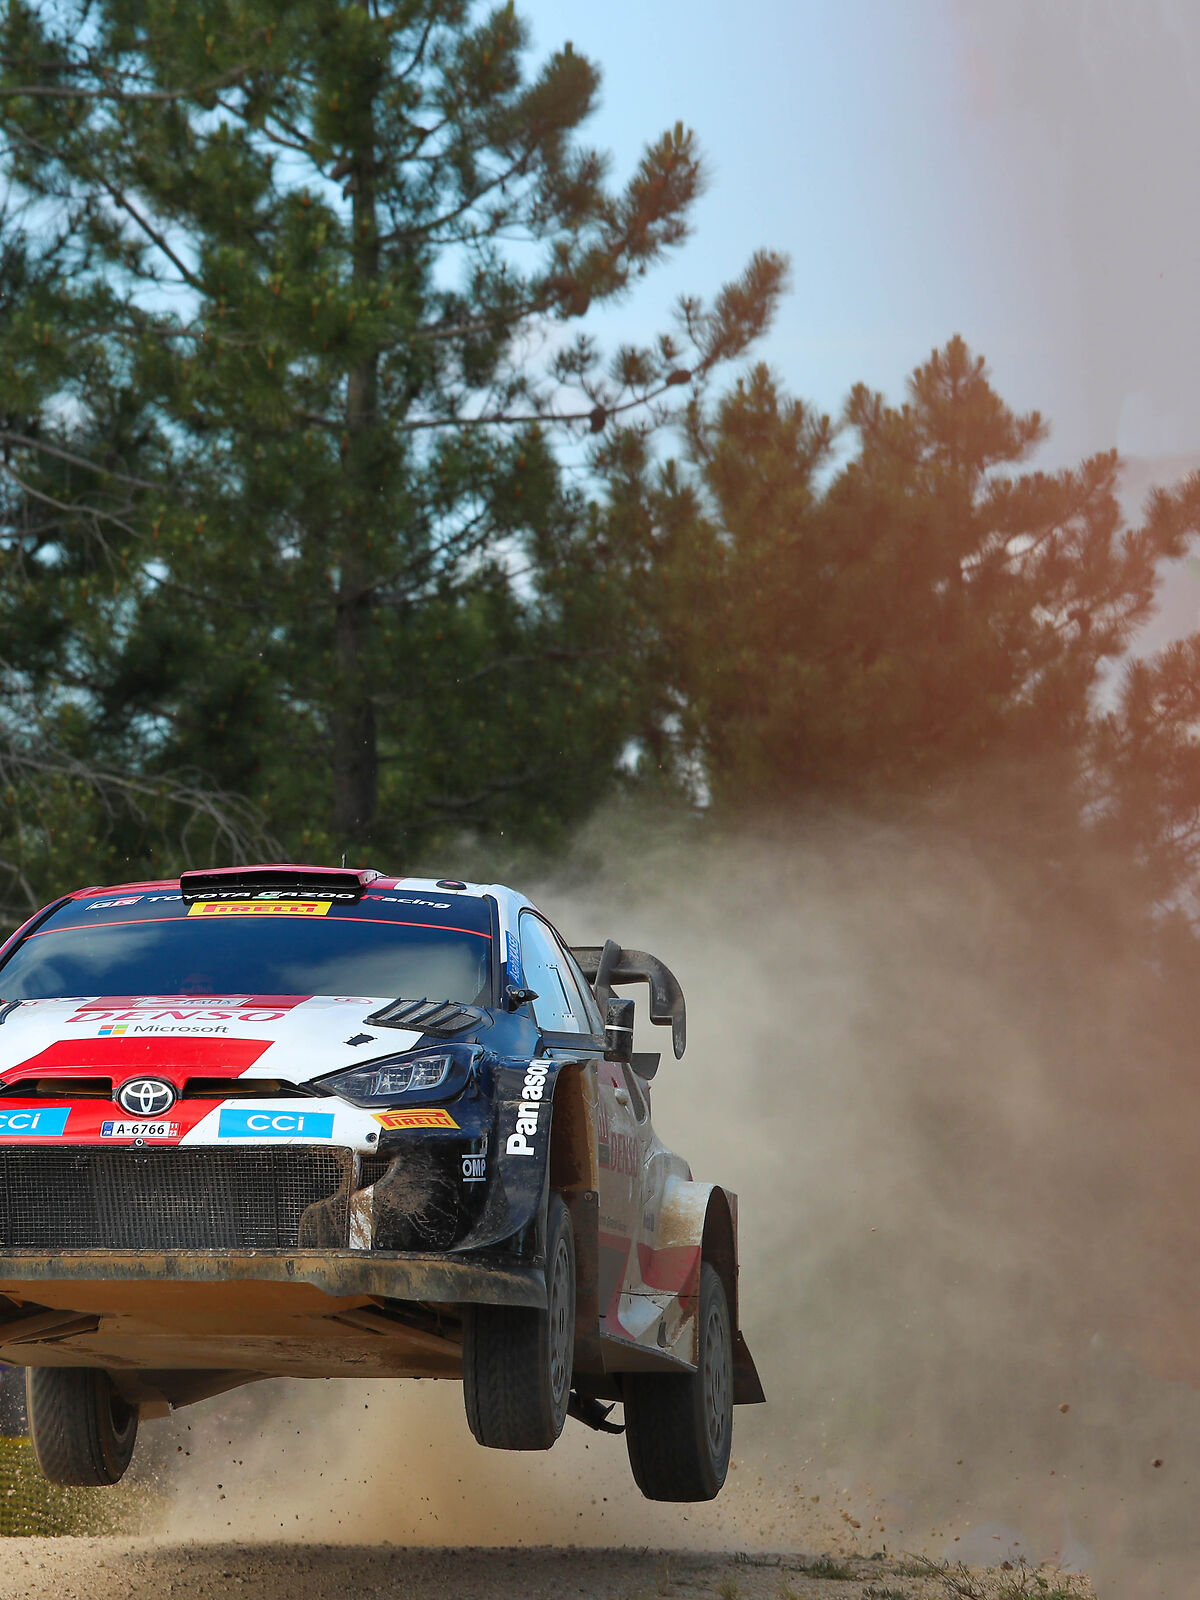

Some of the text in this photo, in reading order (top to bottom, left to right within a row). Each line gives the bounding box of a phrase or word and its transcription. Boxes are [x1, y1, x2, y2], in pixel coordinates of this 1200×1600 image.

[147, 892, 250, 902] TOYOTA
[252, 891, 355, 900] GAZOO
[361, 894, 451, 909] Racing
[202, 903, 318, 913] PIRELLI
[64, 1010, 286, 1023] DENSO
[133, 1025, 230, 1033] Microsoft
[379, 1112, 452, 1127] PIRELLI
[116, 1124, 165, 1135] A-6766
[462, 1159, 486, 1177] OMP
